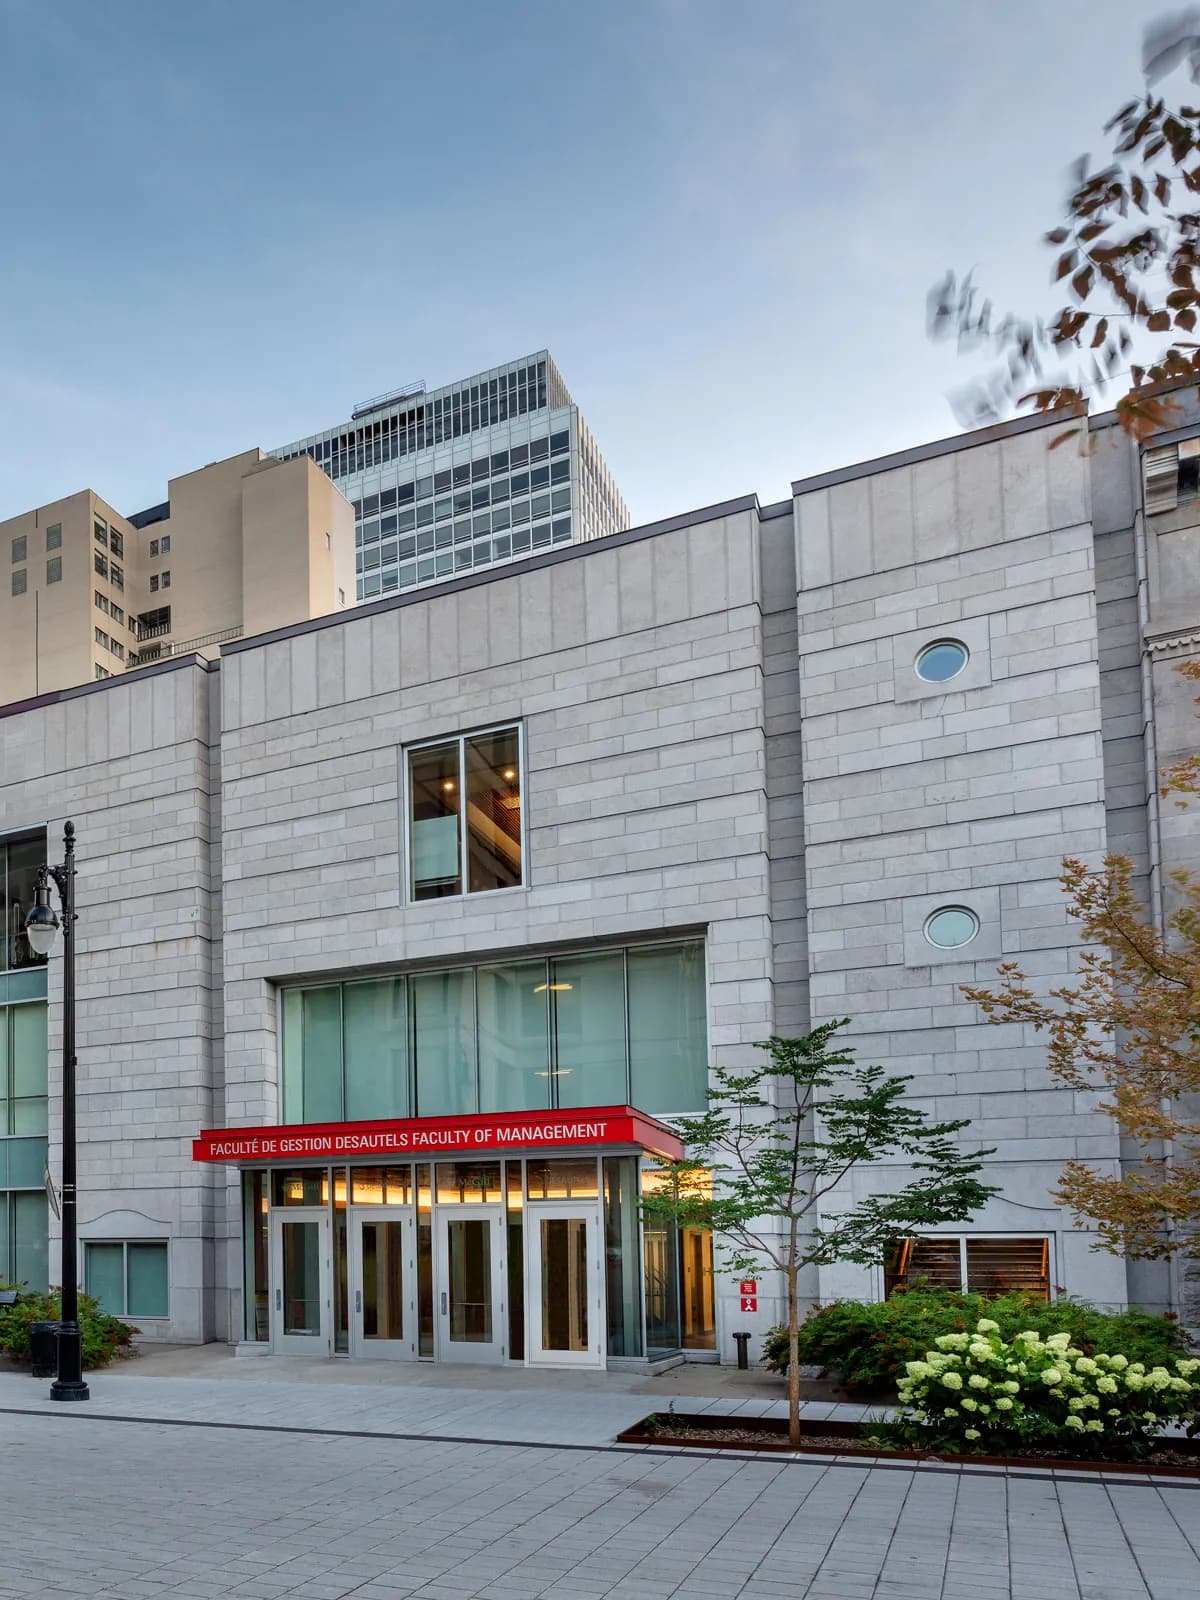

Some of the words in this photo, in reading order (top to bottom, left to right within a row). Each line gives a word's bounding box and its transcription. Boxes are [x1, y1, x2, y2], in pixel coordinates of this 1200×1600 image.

[210, 1138, 259, 1156] FACULTÉ
[262, 1140, 279, 1153] DE
[280, 1136, 332, 1152] GESTION
[335, 1132, 409, 1149] DESAUTELS
[412, 1129, 471, 1146] FACULTY
[474, 1128, 493, 1143] OF
[496, 1122, 607, 1142] MANAGEMENT
